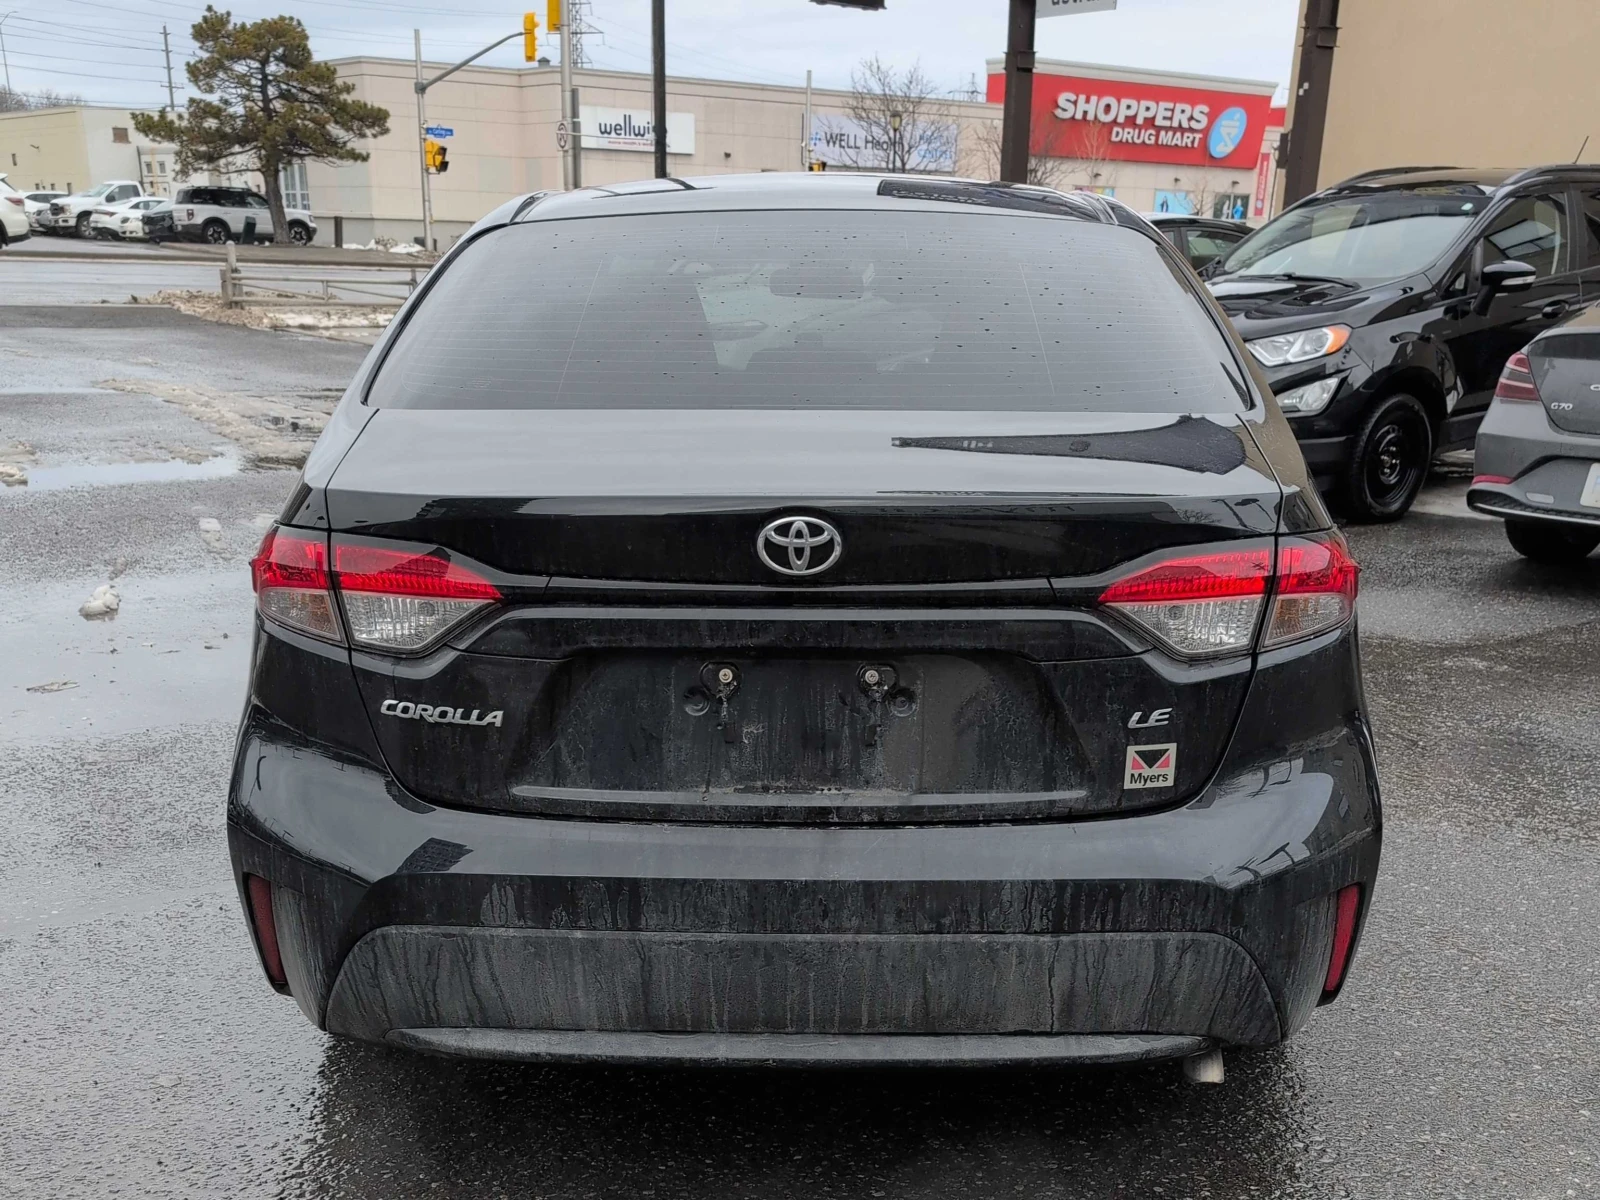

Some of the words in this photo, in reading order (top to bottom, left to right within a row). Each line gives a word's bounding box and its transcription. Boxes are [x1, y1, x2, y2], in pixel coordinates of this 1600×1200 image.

[1054, 92, 1210, 130] SHOPPERS
[598, 114, 667, 137] wellwi
[824, 131, 861, 150] WELL
[1111, 127, 1156, 145] DRUG
[1158, 130, 1203, 148] MART
[1551, 402, 1573, 410] G70
[380, 699, 504, 727] COROLLA
[1127, 708, 1173, 729] LE
[1129, 773, 1169, 787] Myers
